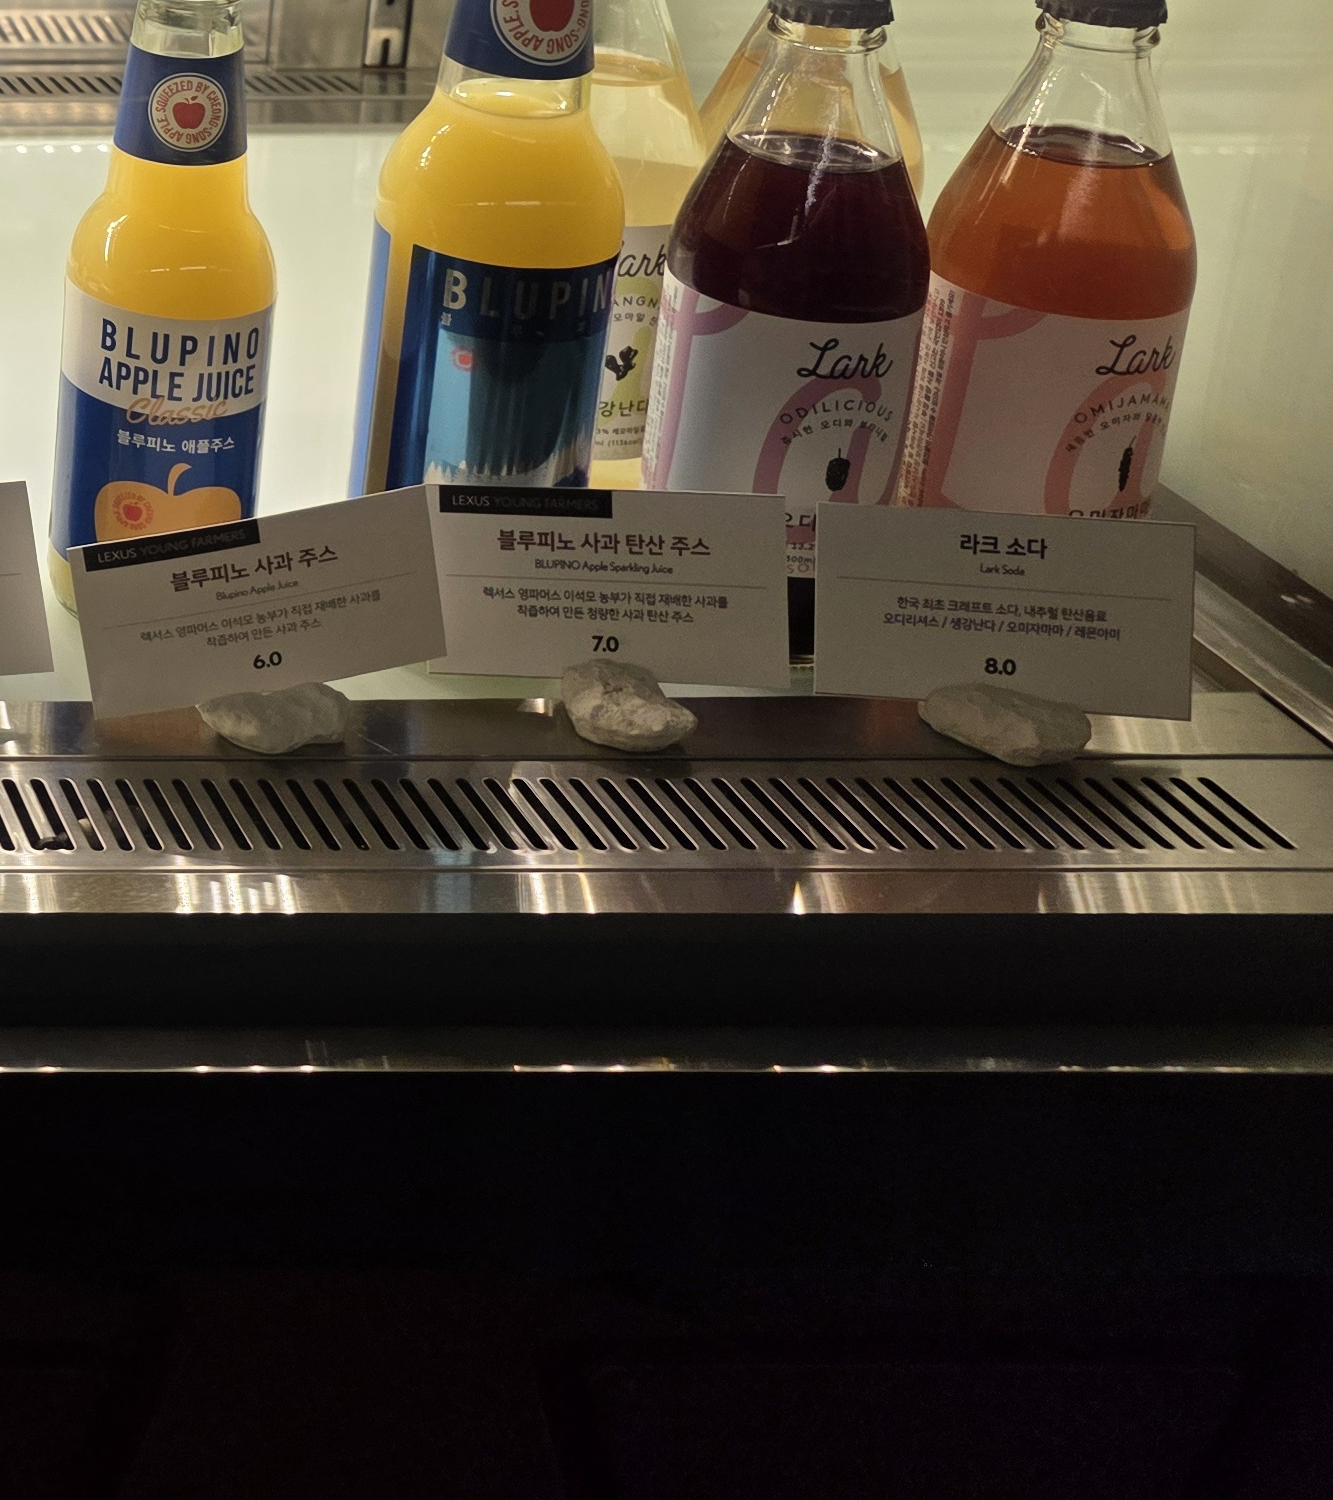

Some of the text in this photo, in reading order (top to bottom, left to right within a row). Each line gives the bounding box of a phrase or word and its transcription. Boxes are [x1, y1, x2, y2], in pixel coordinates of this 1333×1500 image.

[155, 80, 193, 113] SQUEEZED
[195, 81, 211, 95] BY
[101, 318, 259, 367] BLUPINO
[1095, 334, 1177, 376] Lark
[796, 337, 893, 380] Lark
[98, 356, 256, 402] APPLE JUICE
[126, 396, 229, 426] Classic
[779, 398, 894, 426] ODILICIOUS
[116, 428, 235, 454] 블루피노 애플주스
[496, 529, 711, 557] 블루피노 사과 탄산 주스
[959, 533, 1048, 560] 라크 소다
[170, 545, 339, 593] 블루피노 사과 주스
[591, 635, 620, 653] 7.0
[252, 651, 283, 670] 6.0
[983, 657, 1017, 676] 8.0
